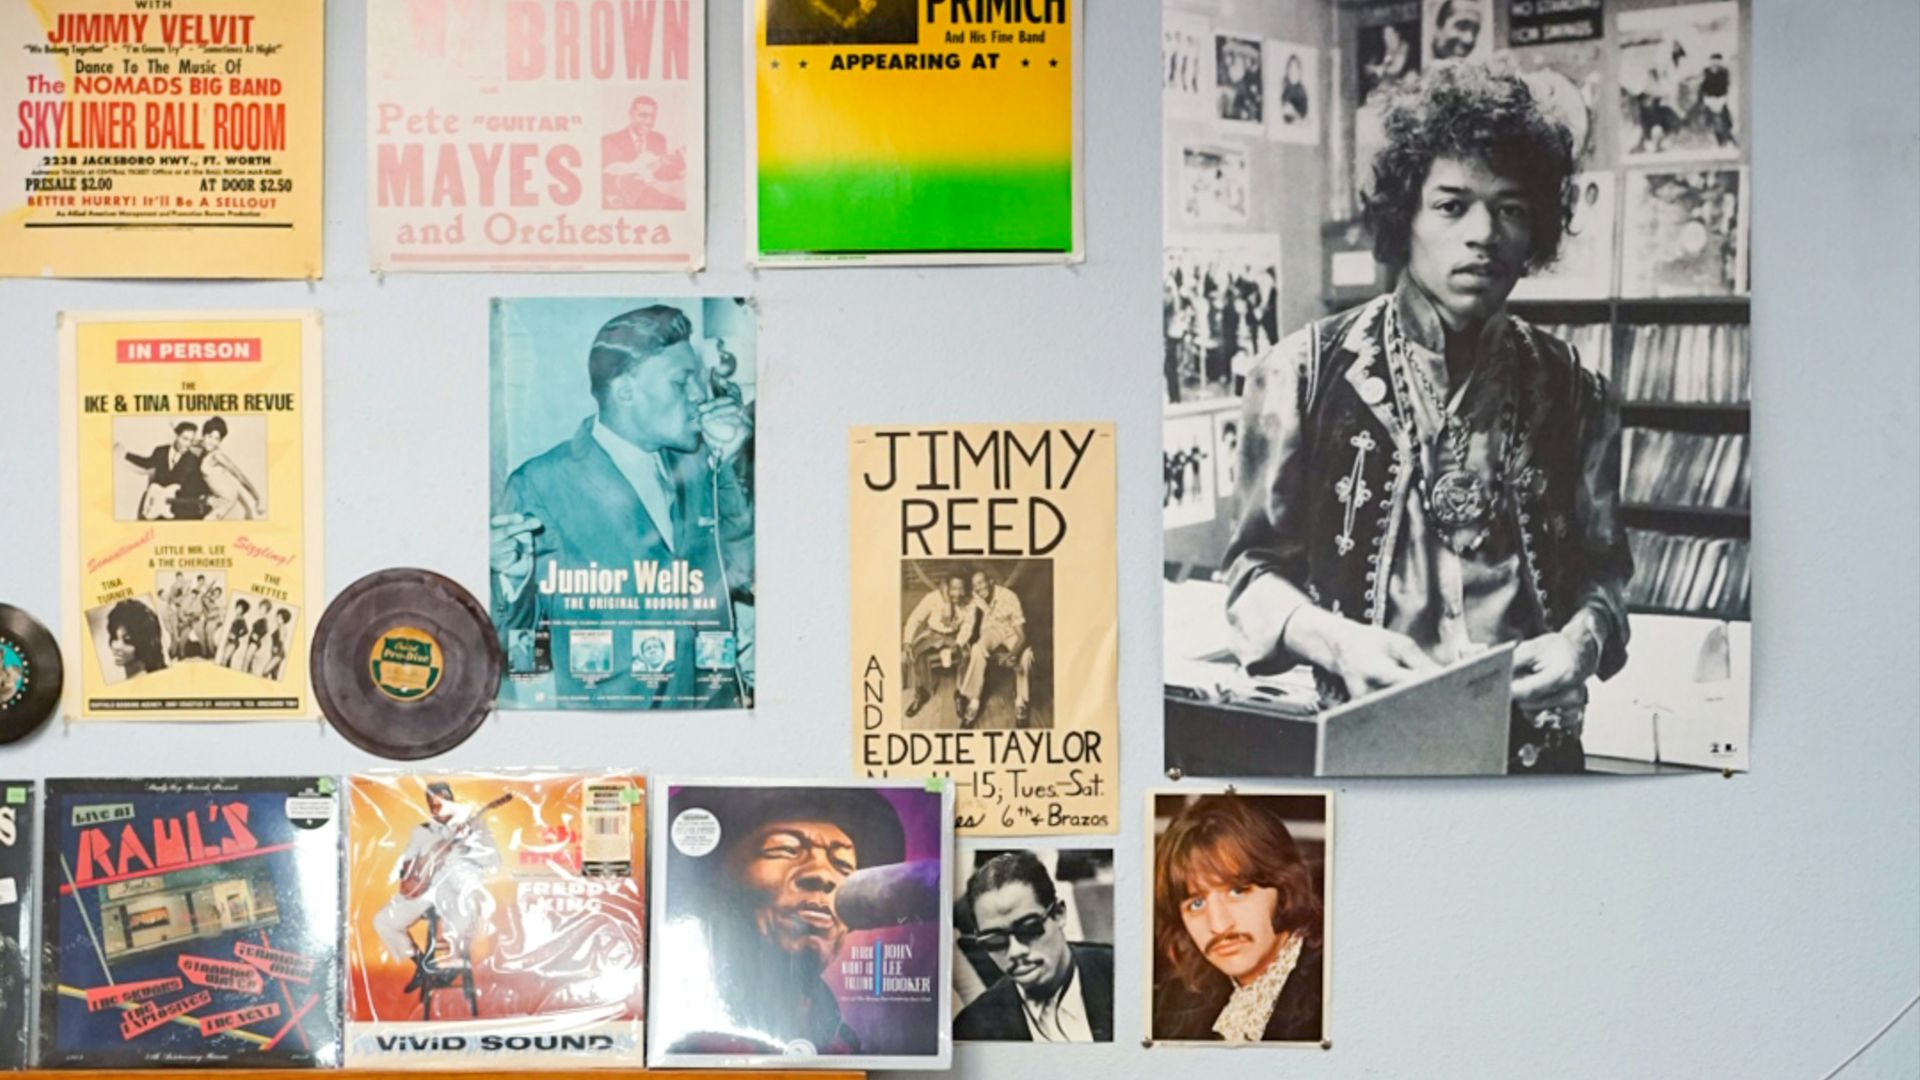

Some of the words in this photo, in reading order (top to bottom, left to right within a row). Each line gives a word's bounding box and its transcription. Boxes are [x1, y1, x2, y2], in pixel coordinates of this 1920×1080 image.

[48, 13, 148, 44] JIMMY
[160, 14, 255, 45] VELVIT
[944, 31, 964, 43] And
[970, 31, 986, 43] His
[991, 31, 1014, 43] Fine
[1019, 30, 1045, 43] Band
[506, 0, 689, 81] BROWN
[75, 58, 113, 74] Dance
[122, 59, 139, 74] To
[147, 58, 170, 74] The
[179, 58, 217, 74] Music
[225, 58, 242, 74] Of
[830, 53, 960, 71] APPEARING
[971, 53, 999, 70] AT
[26, 73, 66, 94] The
[74, 76, 182, 95] NOMADS
[190, 76, 223, 96] BIG
[229, 77, 282, 97] BAND
[18, 101, 136, 150] SKYLINER
[145, 102, 205, 150] BALL
[213, 103, 286, 151] ROOM
[376, 102, 460, 135] Pete
[472, 115, 583, 132] "GUITAR"
[43, 156, 77, 165] 2238
[82, 156, 154, 165] JACKSBORO
[203, 156, 221, 165] FT.
[225, 156, 271, 165] WORTH
[377, 143, 582, 208] MAYES
[25, 178, 76, 191] PRESALE
[81, 178, 113, 192] $2.00
[199, 178, 217, 192] AT
[221, 178, 255, 192] DOOR
[260, 178, 293, 193] $2.50
[27, 195, 76, 206] BETTER
[81, 195, 136, 207] HURRY!
[176, 197, 193, 207] Be
[200, 197, 209, 207] A
[216, 197, 277, 208] SELLOUT
[396, 213, 466, 244] and
[484, 212, 672, 246] Orchestra
[128, 343, 151, 360] IN
[159, 342, 250, 359] PERSON
[182, 382, 196, 391] THE
[84, 395, 109, 413] IKE
[114, 395, 128, 412] &
[133, 394, 170, 412] TINA
[176, 393, 239, 412] TURNER
[244, 393, 294, 411] REVUE
[864, 429, 1096, 491] JIMMY
[901, 496, 1067, 556] REED
[155, 546, 184, 555] LITTLE
[208, 546, 225, 555] LEE
[158, 558, 175, 568] THE
[178, 558, 233, 568] CHEROKEES
[101, 578, 123, 591] TINA
[263, 573, 282, 586] THE
[539, 560, 629, 595] Junior
[633, 559, 704, 595] Wells
[96, 588, 134, 604] TURNER
[251, 584, 289, 601] IKETTES
[564, 597, 584, 609] THE
[589, 597, 640, 609] ORIGINAL
[693, 597, 717, 610] MAN
[864, 732, 975, 765] EDDIE
[983, 731, 1102, 764] TAYLOR
[1049, 803, 1109, 827] Brazos
[75, 802, 258, 882] RAUL'S
[883, 944, 912, 960] JOHN
[883, 960, 903, 975] LEE
[883, 976, 931, 992] HOOKER
[480, 1035, 614, 1051] SOUND
